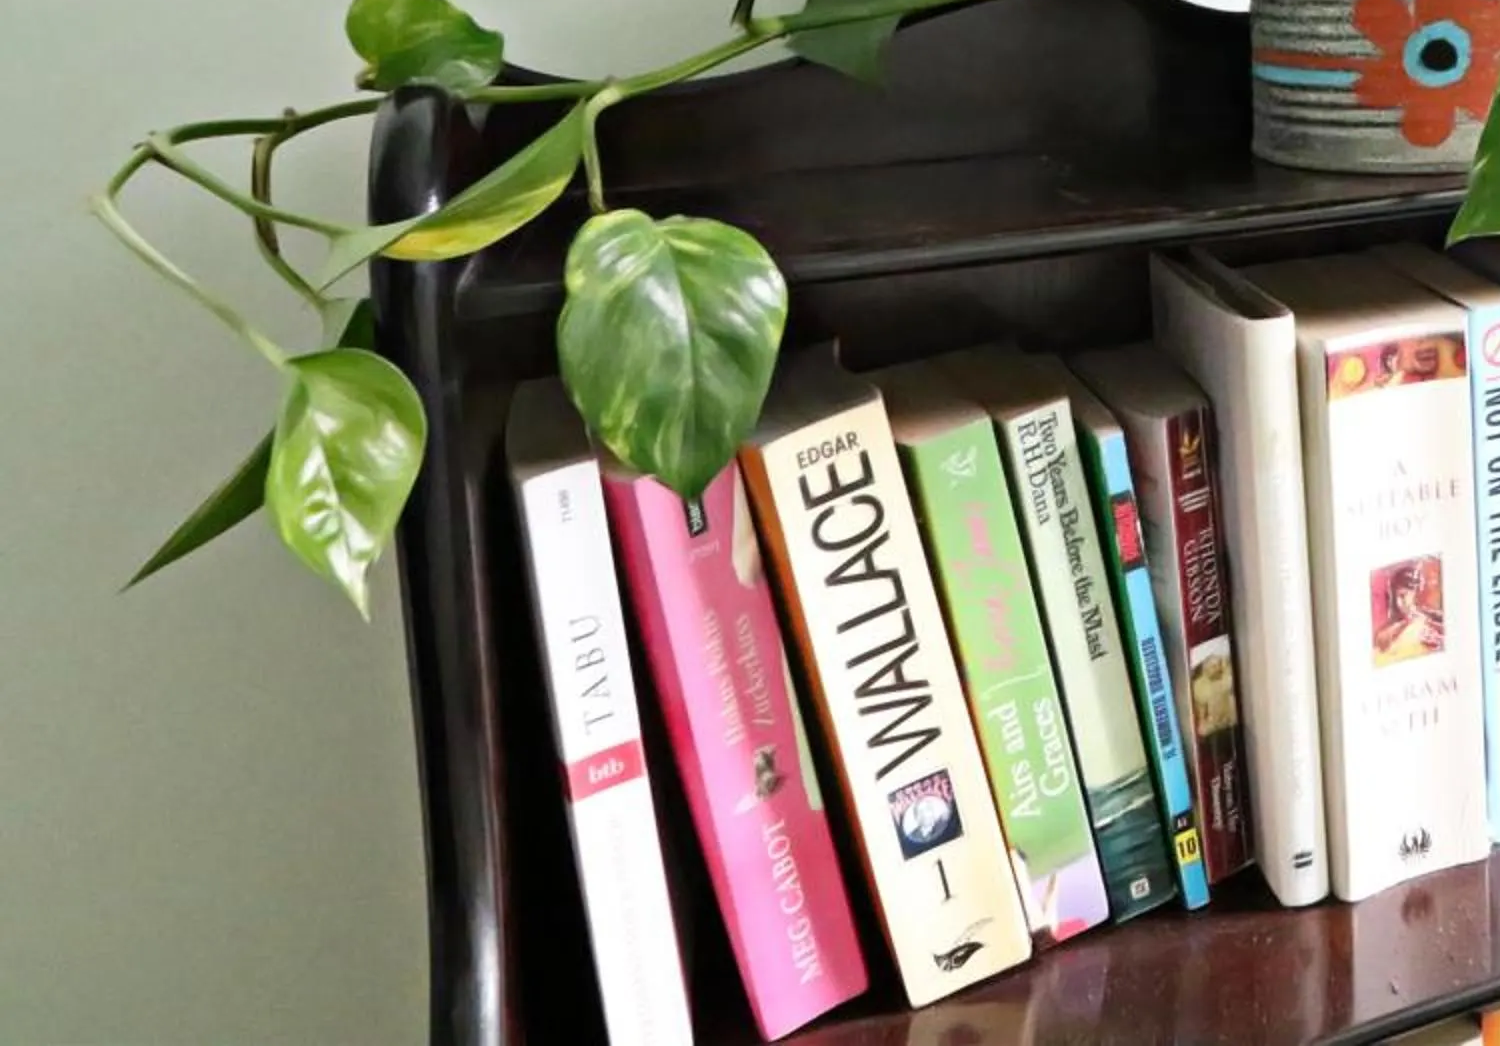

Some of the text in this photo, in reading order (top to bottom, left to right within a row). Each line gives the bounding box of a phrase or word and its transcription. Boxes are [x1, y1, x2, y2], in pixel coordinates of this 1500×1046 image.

[797, 432, 860, 469] EDGAR
[1037, 410, 1107, 663] Two Years Before the Mast
[1182, 539, 1206, 623] GIBSON
[1197, 525, 1221, 624] RHONDA
[799, 449, 941, 781] WALLACE
[569, 614, 615, 735] TABU
[587, 755, 625, 785] btb
[988, 700, 1027, 755] and
[1032, 700, 1070, 797] Graces
[1011, 758, 1042, 818] Airs
[1179, 836, 1197, 858] 10
[762, 820, 824, 986] MEG CABOT
